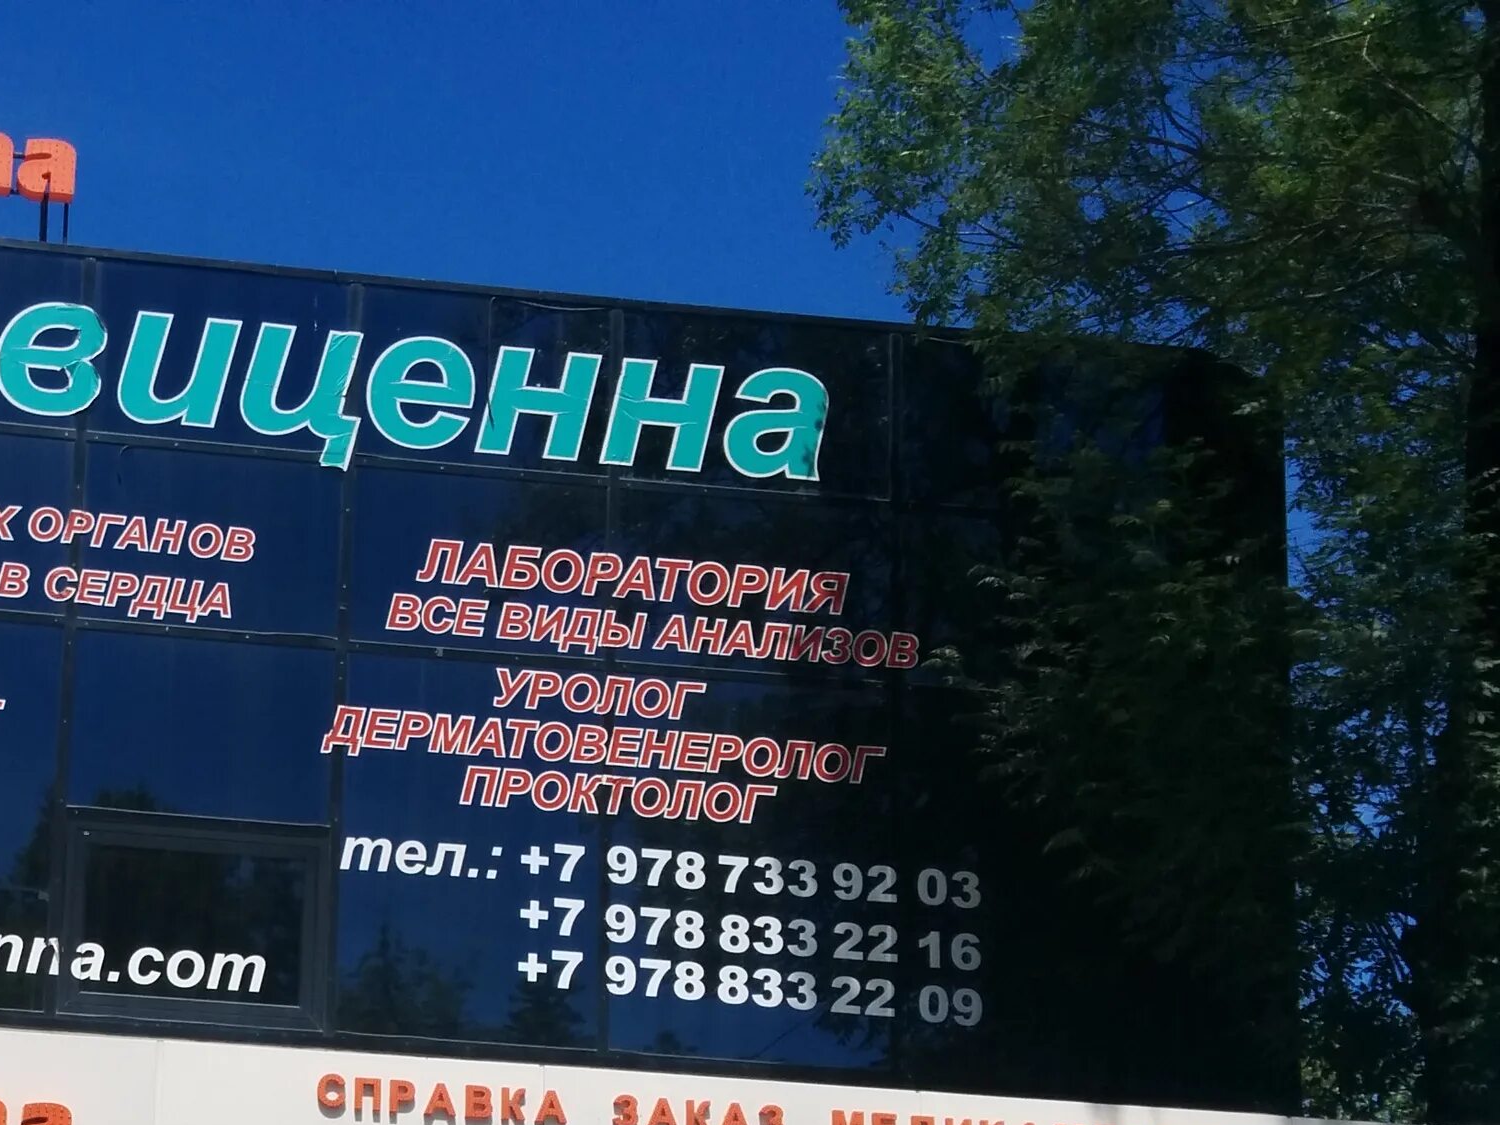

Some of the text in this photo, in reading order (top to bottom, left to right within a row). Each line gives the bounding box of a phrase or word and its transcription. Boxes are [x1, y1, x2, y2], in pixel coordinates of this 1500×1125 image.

[27, 506, 257, 563] ОРГАНОВ
[44, 566, 231, 622] СЕРДЦА
[416, 539, 850, 615] ЛАБОРАТОРИЯ
[386, 594, 920, 669] ВСЕ ВИДЫ АНАЛИЗОВ
[493, 667, 706, 721] УРОЛОГ
[321, 705, 886, 785] ДЕРМАТОВЕНЕРОЛОГ
[460, 766, 777, 824] ПРОКТОЛОГ
[340, 836, 981, 909] тел.: +7 978 733 92 03
[521, 897, 981, 972] +7 978 833 22 16
[518, 951, 983, 1026] +7 978 833 22 09
[317, 1073, 567, 1125] СПРАВКА
